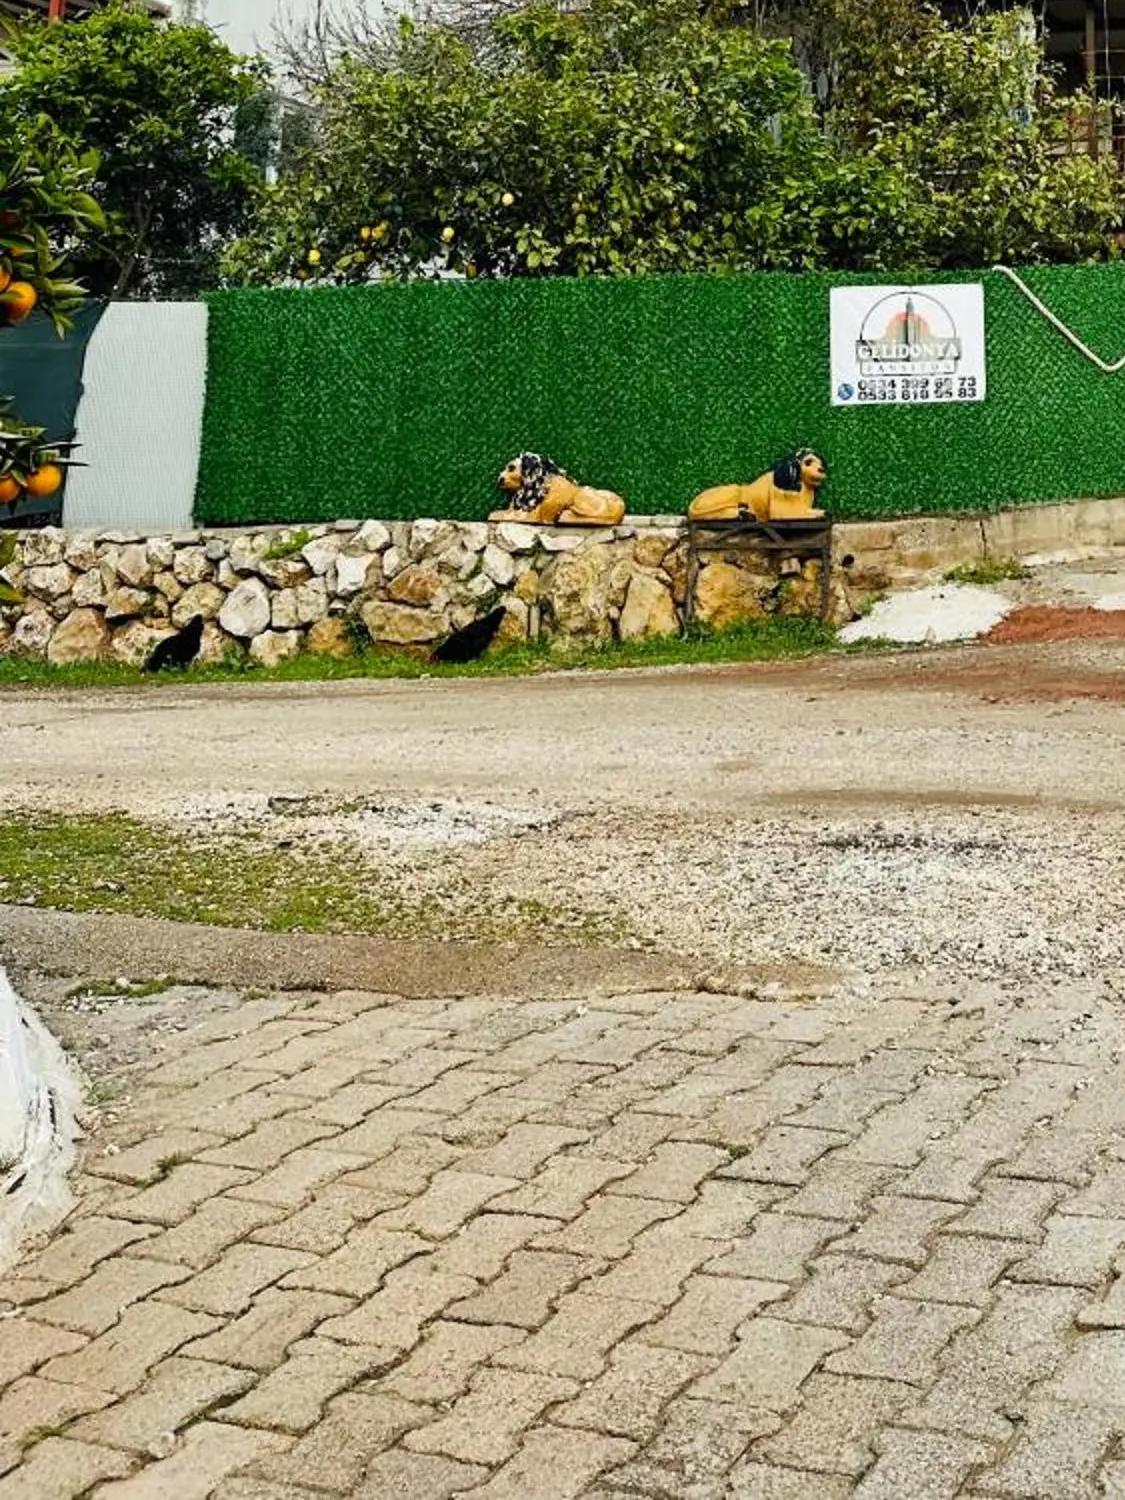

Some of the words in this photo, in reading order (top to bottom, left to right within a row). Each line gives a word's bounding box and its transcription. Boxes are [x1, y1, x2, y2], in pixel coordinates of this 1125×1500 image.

[958, 376, 976, 387] 73
[857, 390, 896, 401] 0533
[958, 387, 976, 398] 83
